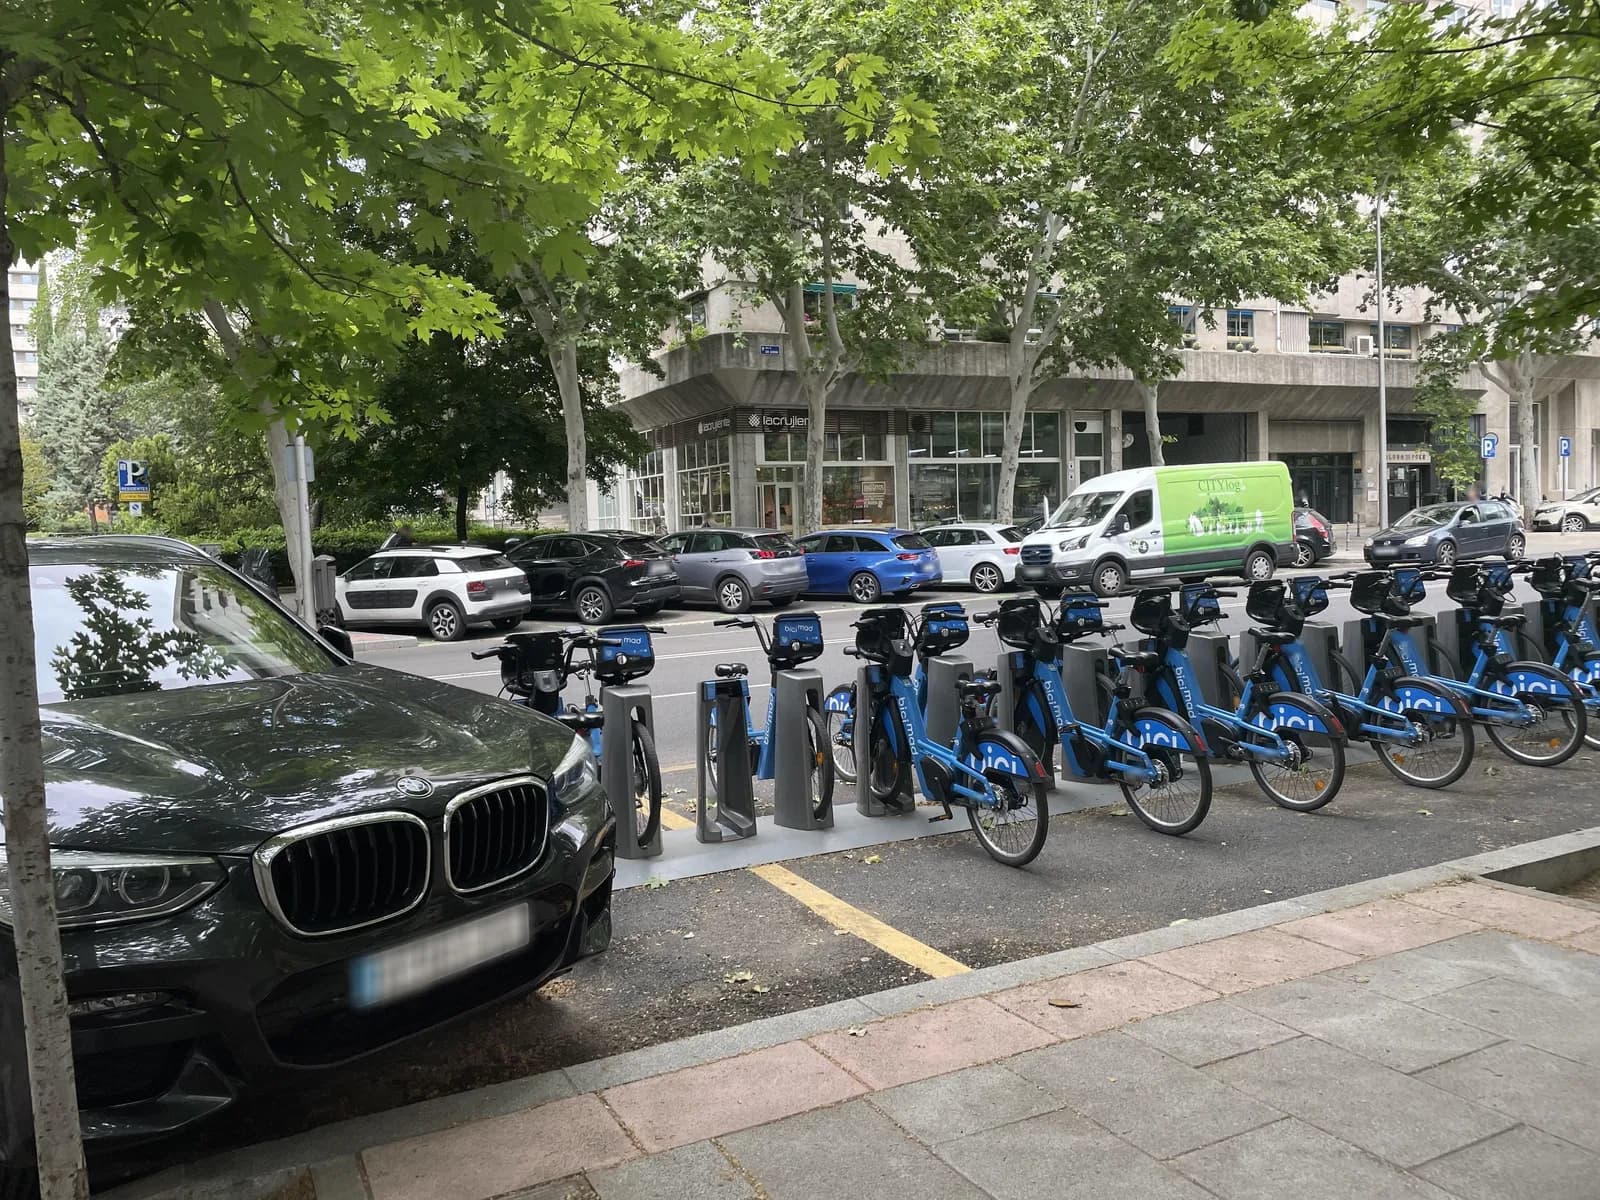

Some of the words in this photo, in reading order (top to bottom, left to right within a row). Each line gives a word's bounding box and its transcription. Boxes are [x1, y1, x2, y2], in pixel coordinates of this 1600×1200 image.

[762, 415, 809, 428] lacrujien
[1484, 440, 1493, 456] P
[1561, 440, 1569, 455] P
[125, 460, 145, 486] P
